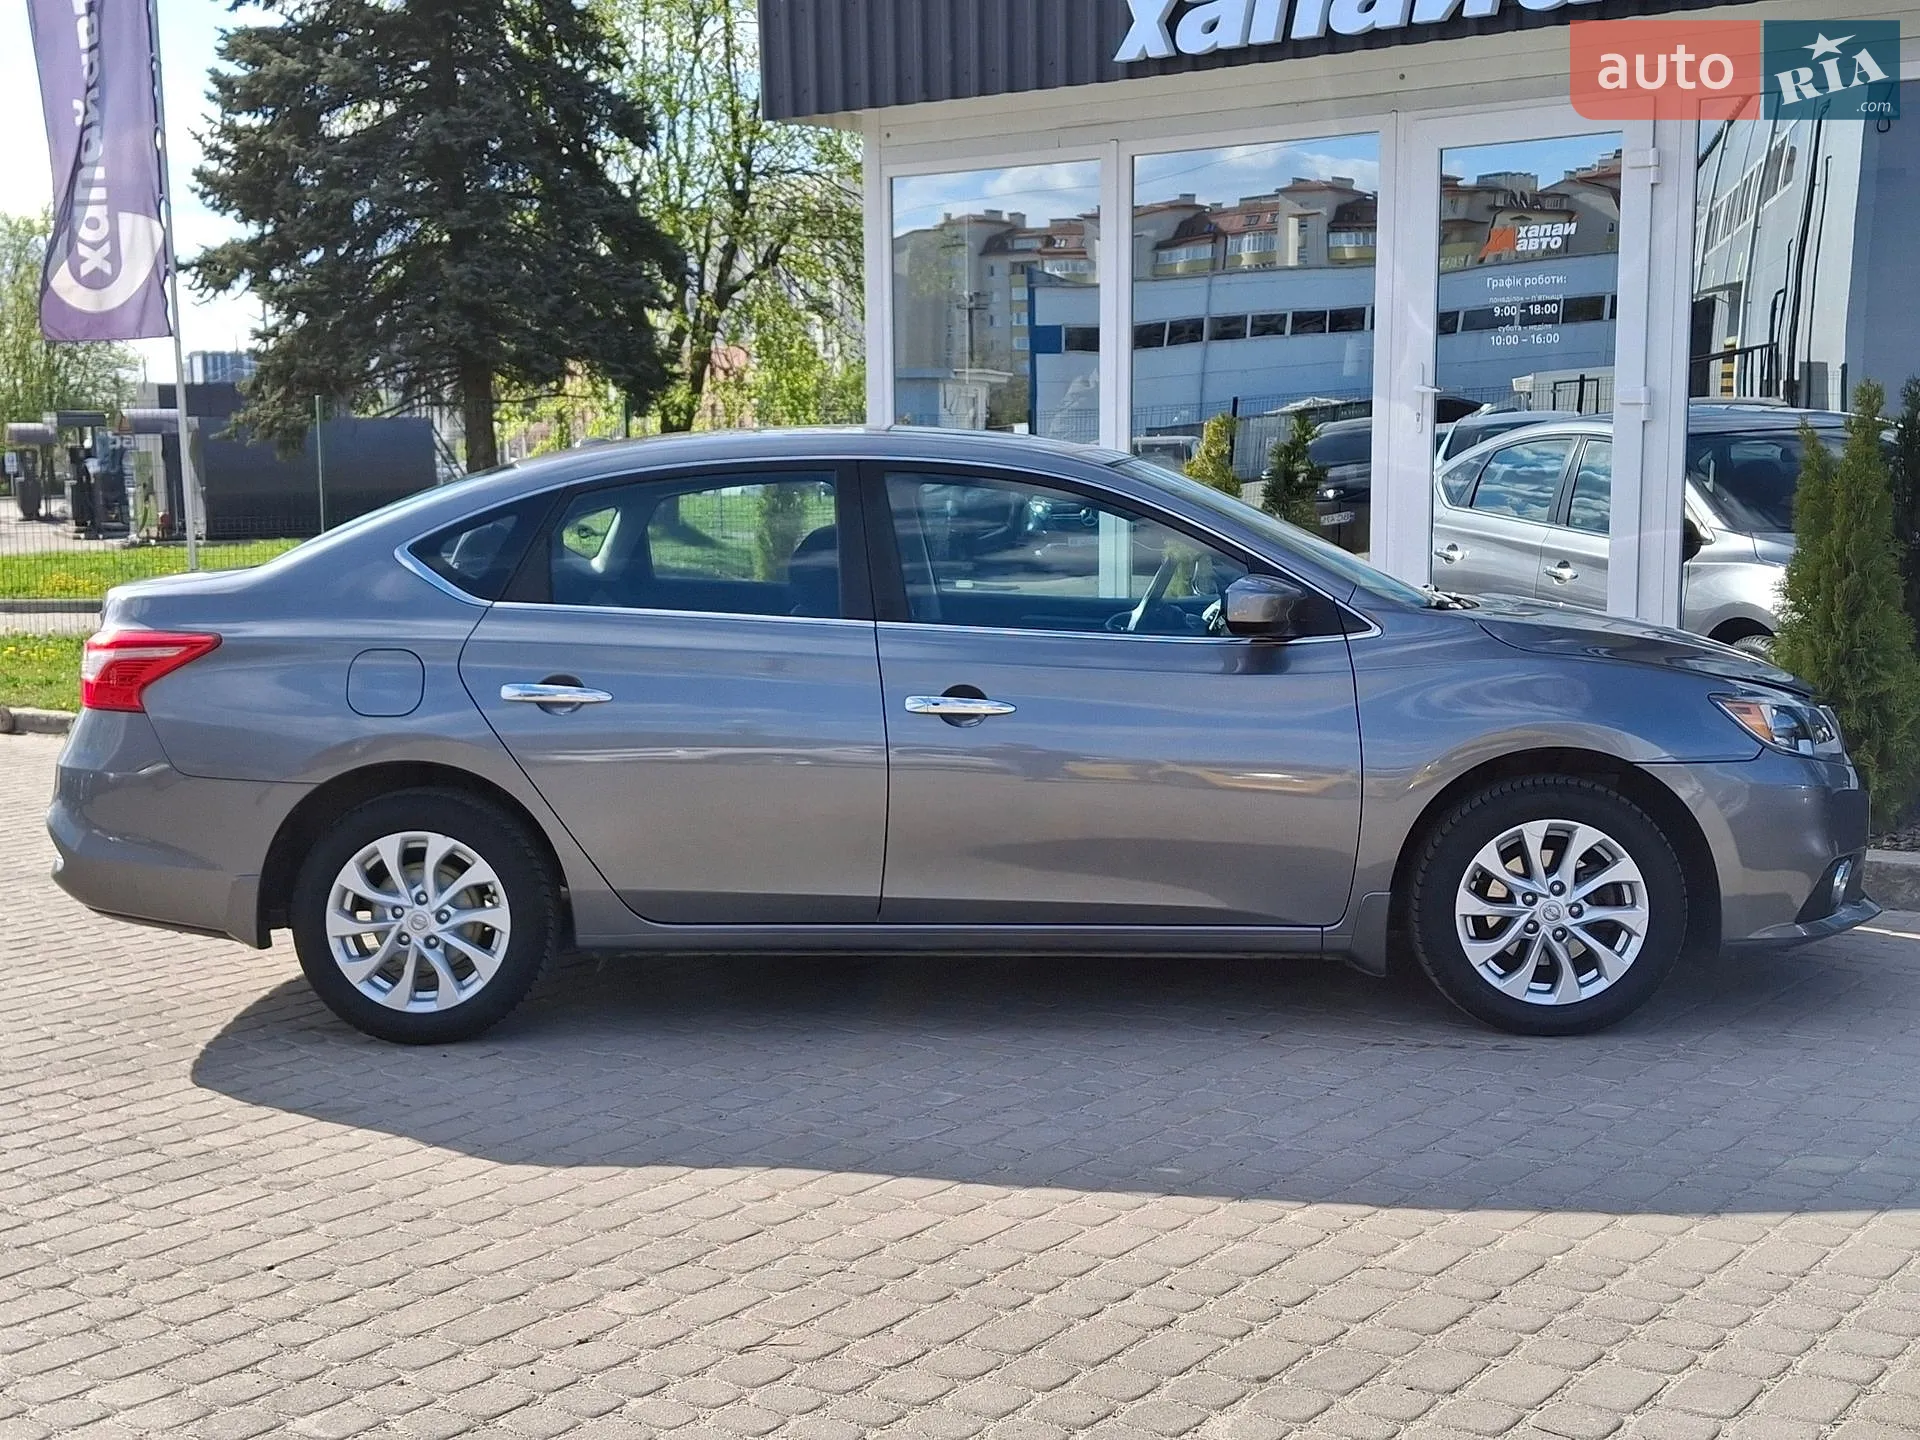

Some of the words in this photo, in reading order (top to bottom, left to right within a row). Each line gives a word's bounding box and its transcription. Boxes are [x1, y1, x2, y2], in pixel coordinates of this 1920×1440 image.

[1113, 0, 1501, 62] хап
[1515, 236, 1562, 252] авто
[1486, 275, 1521, 290] Графік
[1524, 274, 1567, 288] роботи:
[1494, 306, 1517, 317] 9:00
[1529, 303, 1558, 315] 18:00
[1490, 334, 1519, 346] 10:00
[1530, 332, 1560, 344] 16:00
